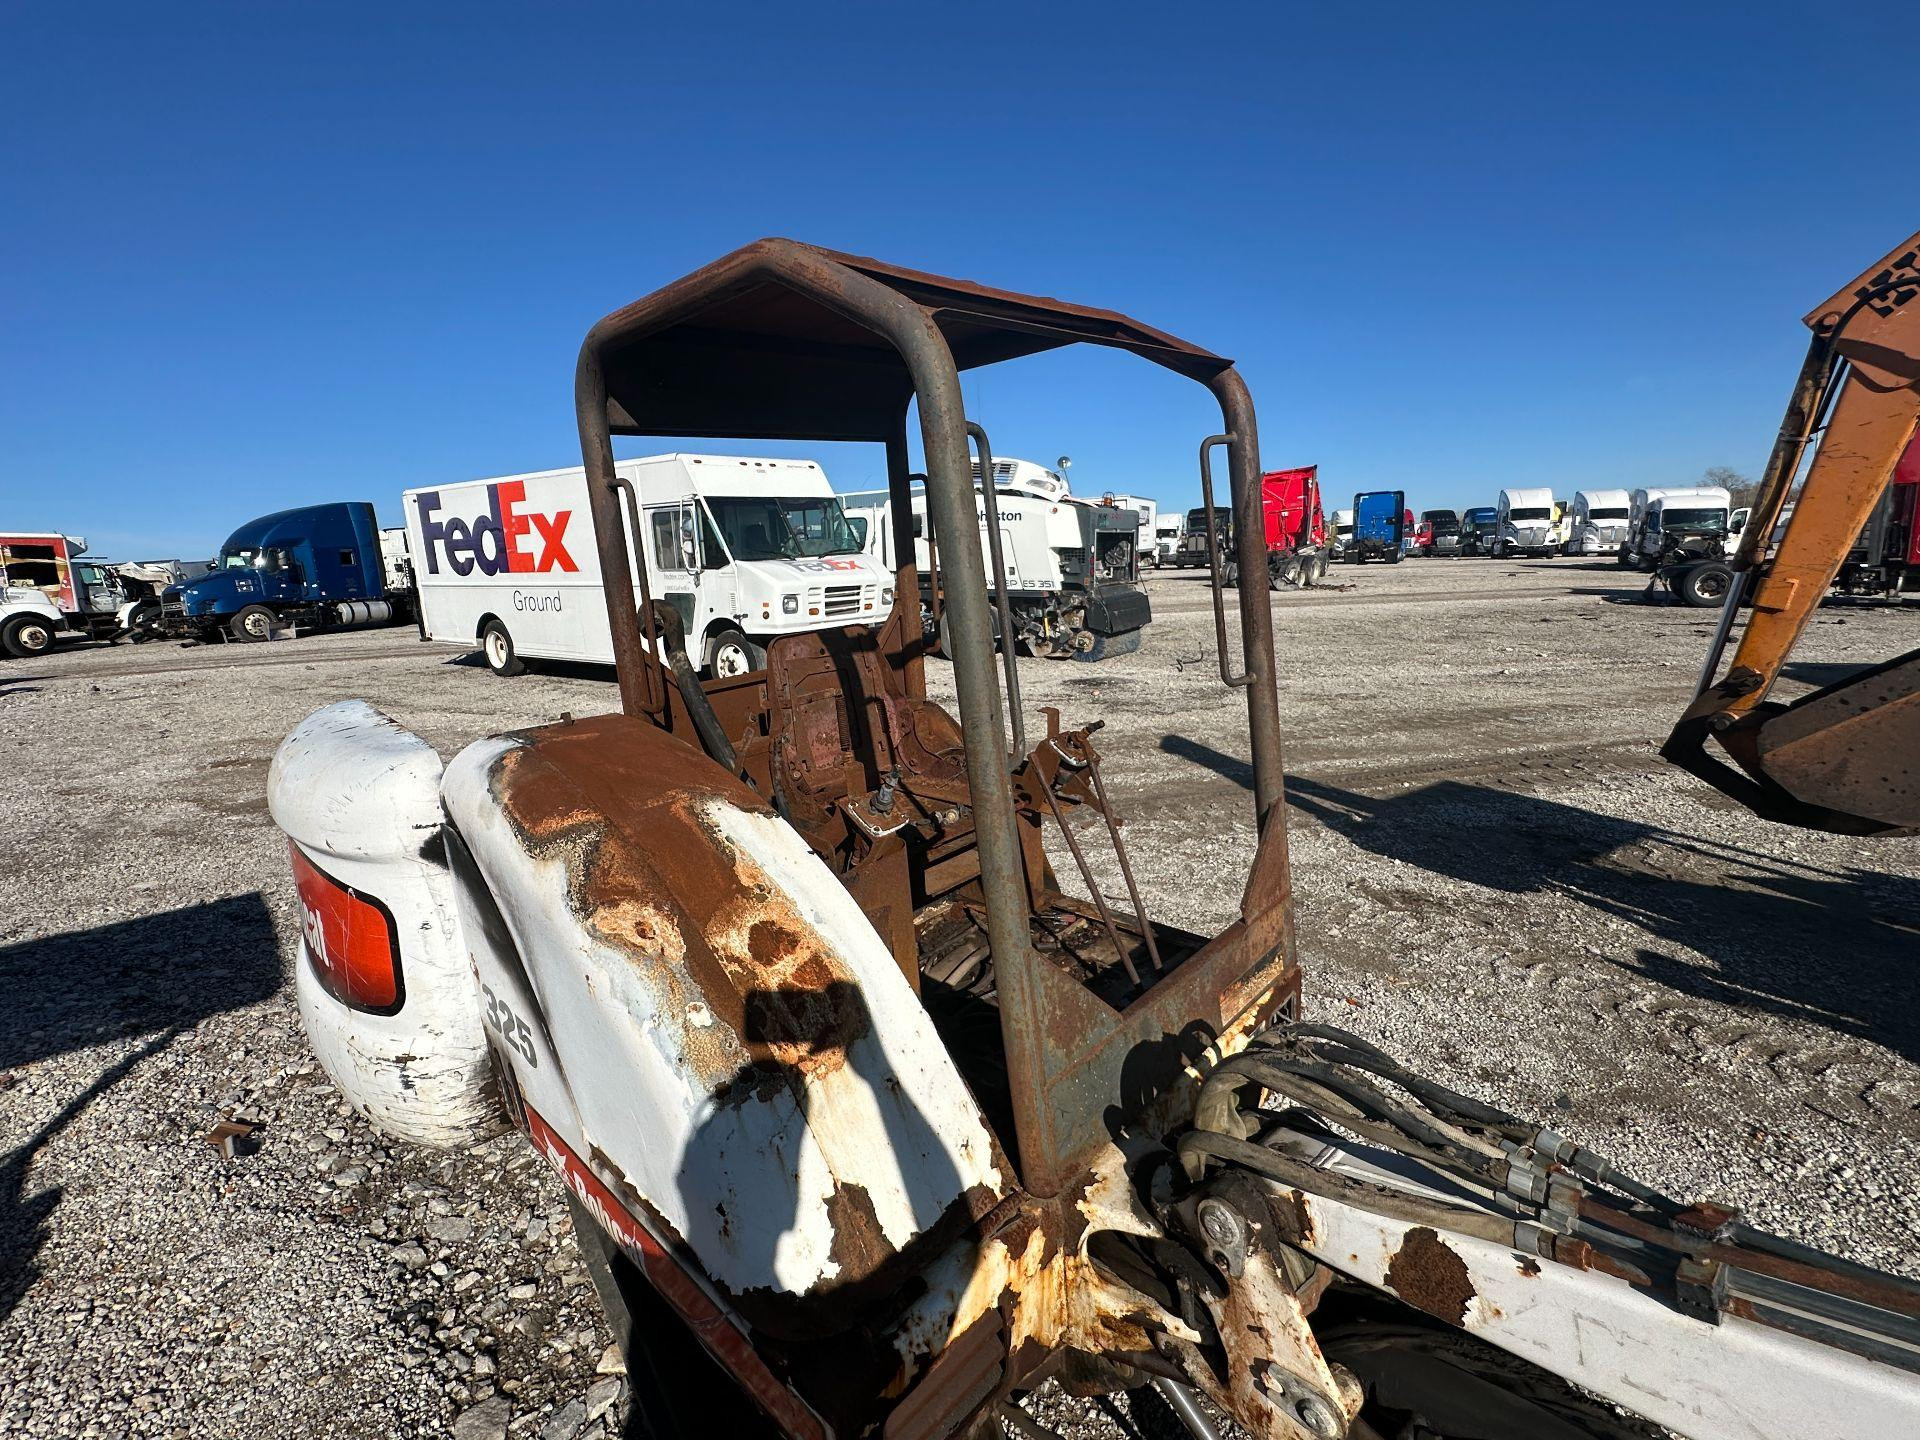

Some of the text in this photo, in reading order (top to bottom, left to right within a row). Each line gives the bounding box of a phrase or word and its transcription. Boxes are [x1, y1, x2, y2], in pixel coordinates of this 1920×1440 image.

[416, 480, 580, 577] FedEx
[784, 559, 866, 573] FedEx
[513, 590, 562, 612] Ground
[482, 984, 538, 1069] 325
